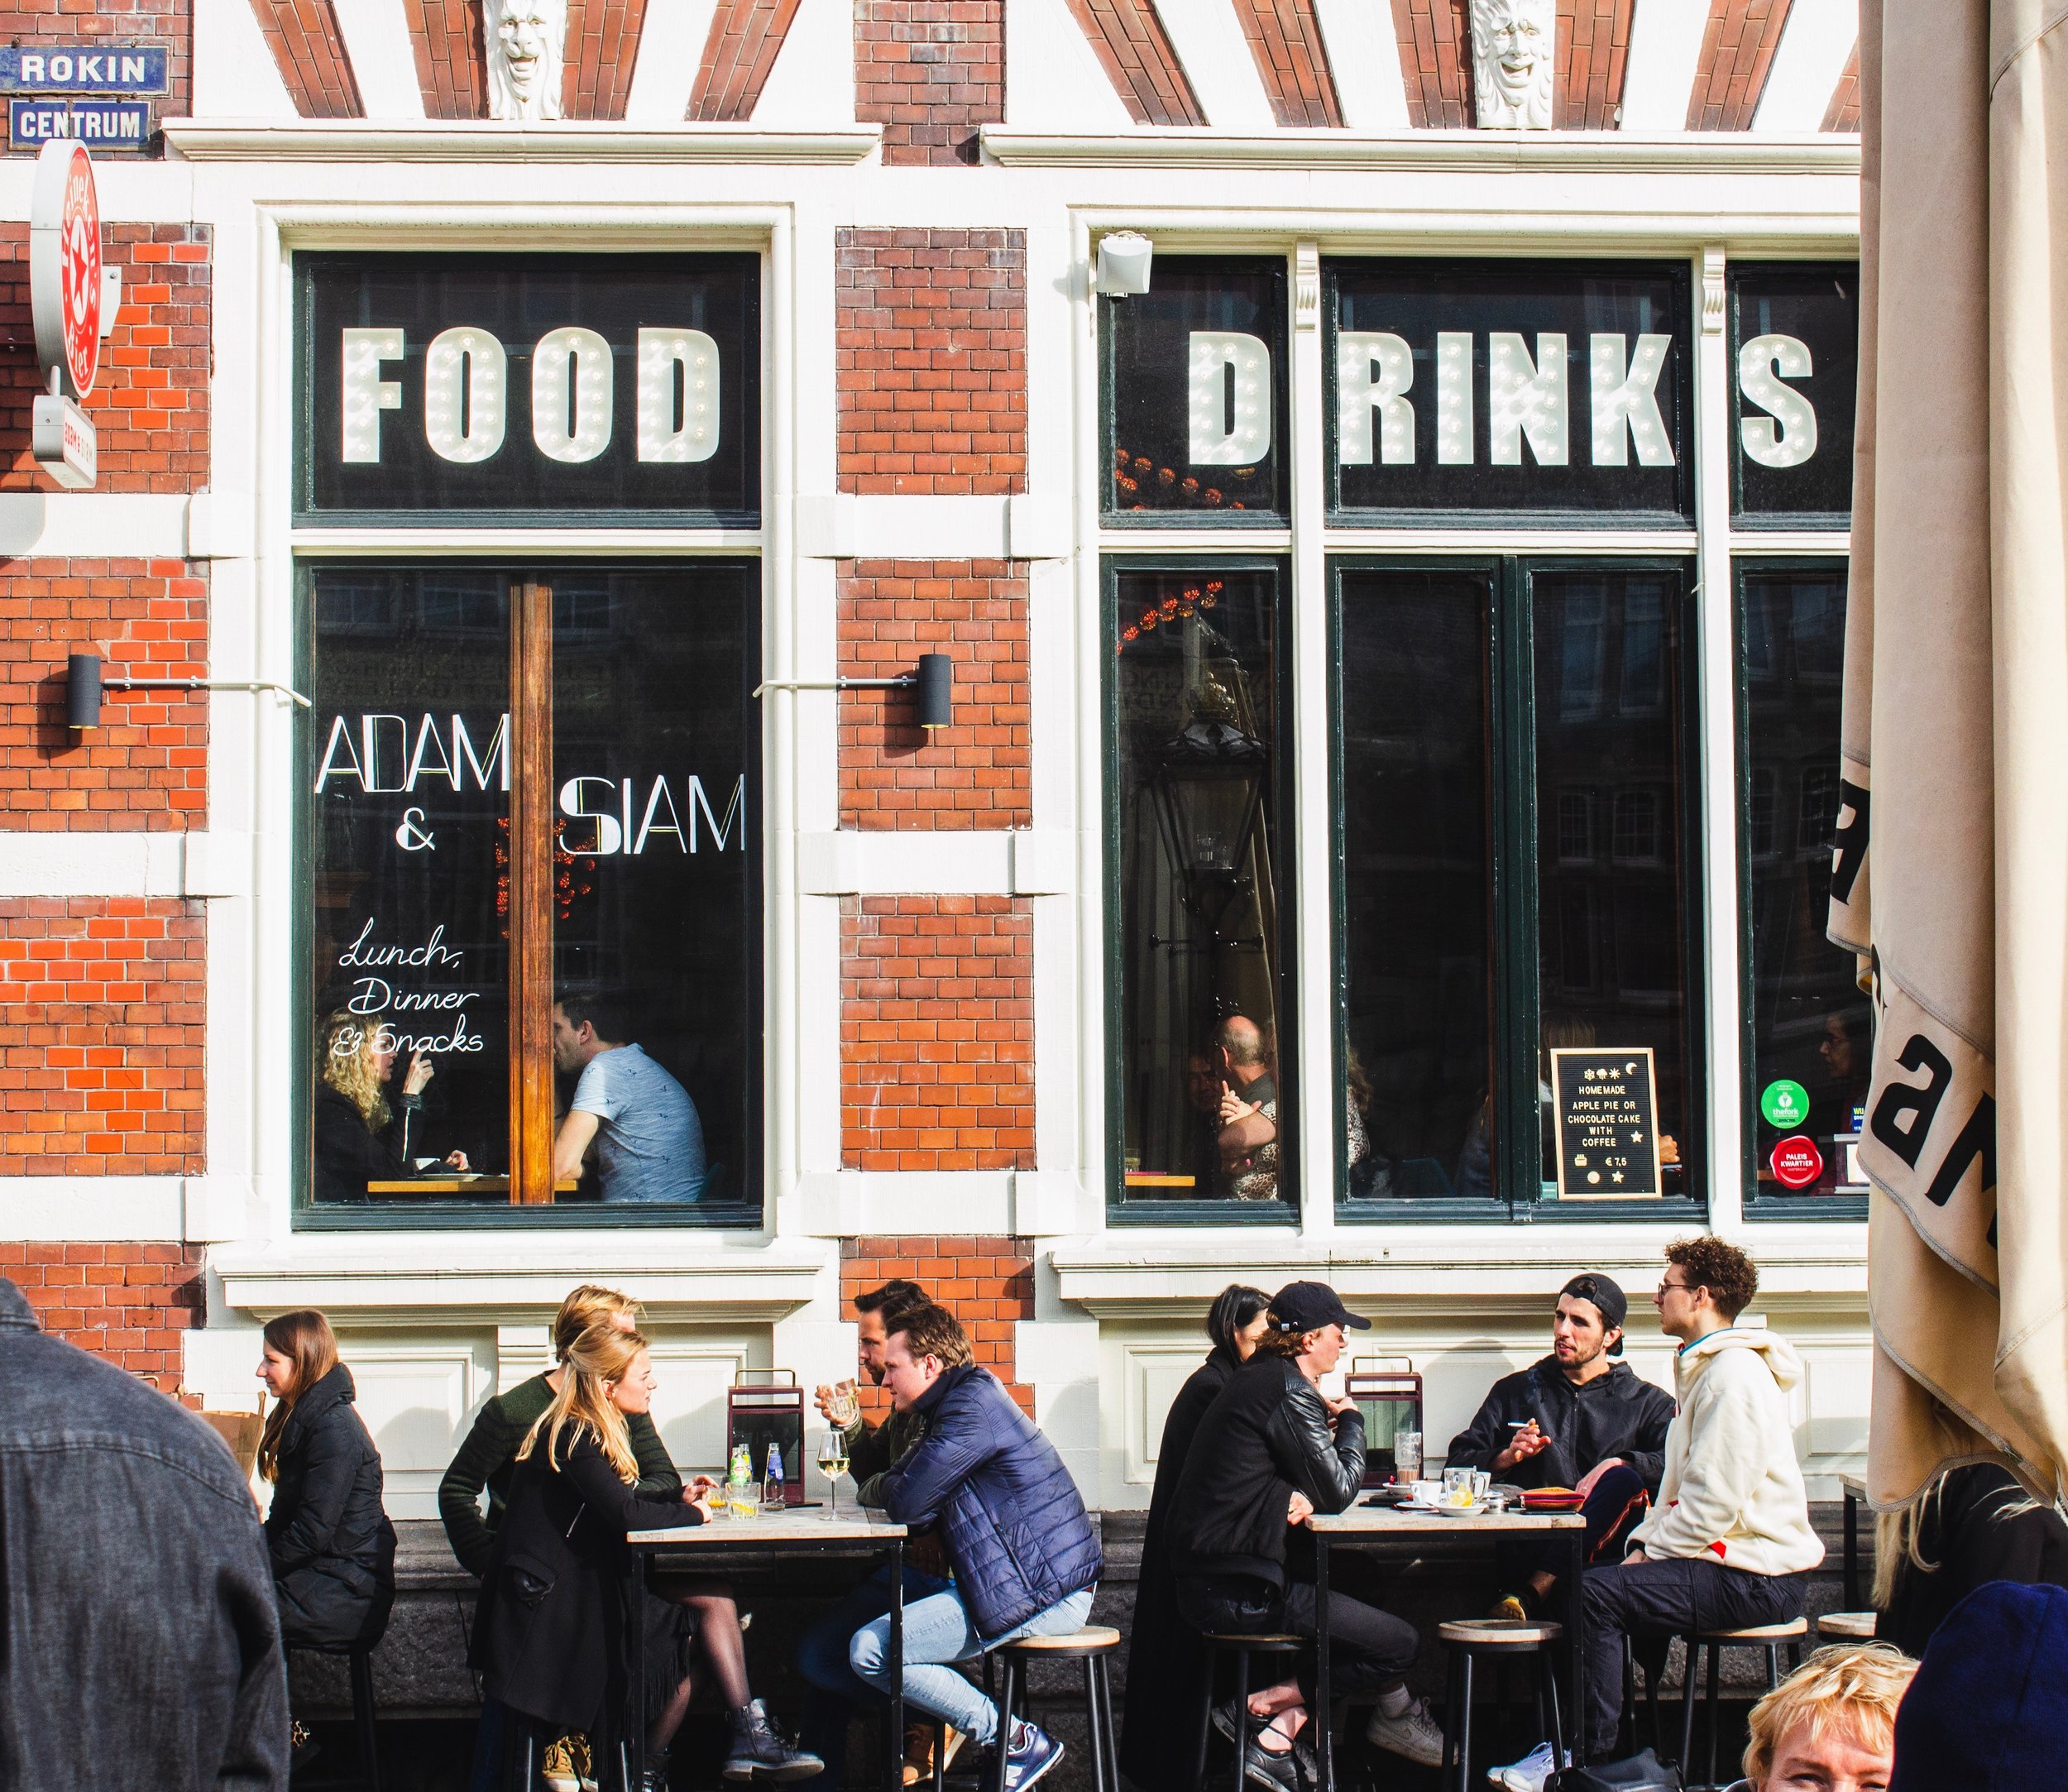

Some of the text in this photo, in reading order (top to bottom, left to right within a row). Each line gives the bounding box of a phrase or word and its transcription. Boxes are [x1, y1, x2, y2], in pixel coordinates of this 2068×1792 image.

[22, 55, 145, 83] ROKIN
[20, 112, 140, 138] CENTRUM
[69, 319, 89, 378] Bier
[342, 326, 720, 463] FOOD
[1189, 331, 1818, 469] DRINKS
[315, 713, 510, 793] ADAM
[396, 774, 745, 855] & SIAM
[338, 917, 463, 969] Lunch,
[347, 977, 480, 1014] Dinner
[333, 1013, 484, 1057] & Snacks
[1568, 1114, 1640, 1124] CHOCOLATE CAKE
[1573, 1101, 1635, 1110] APPLE PIE OR
[1582, 1138, 1616, 1147] COFFEE
[1589, 1126, 1613, 1135] WITH
